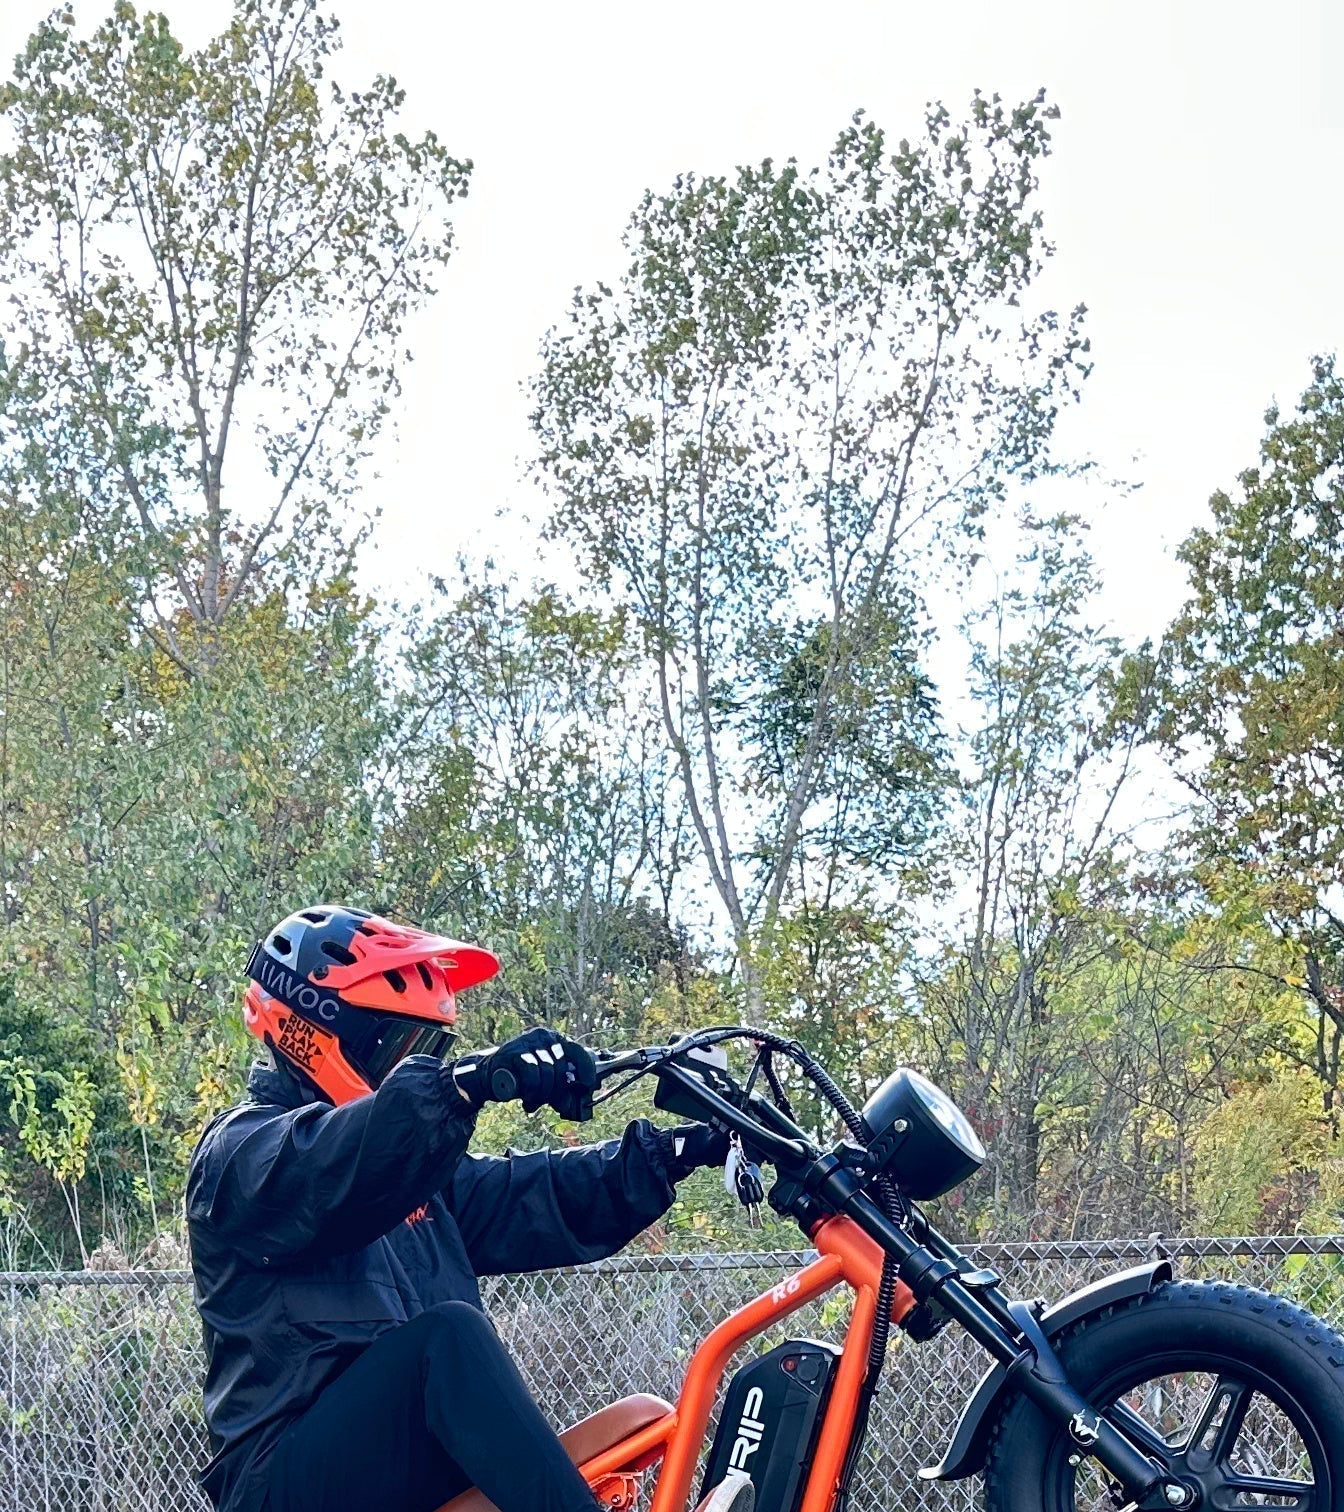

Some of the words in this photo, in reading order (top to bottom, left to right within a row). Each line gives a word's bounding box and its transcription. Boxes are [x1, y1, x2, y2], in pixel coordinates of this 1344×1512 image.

[284, 1024, 316, 1051] PLAY
[288, 1014, 315, 1039] RUN
[279, 1034, 313, 1065] BACK
[772, 1275, 801, 1305] R6
[727, 1386, 765, 1480] RIP
